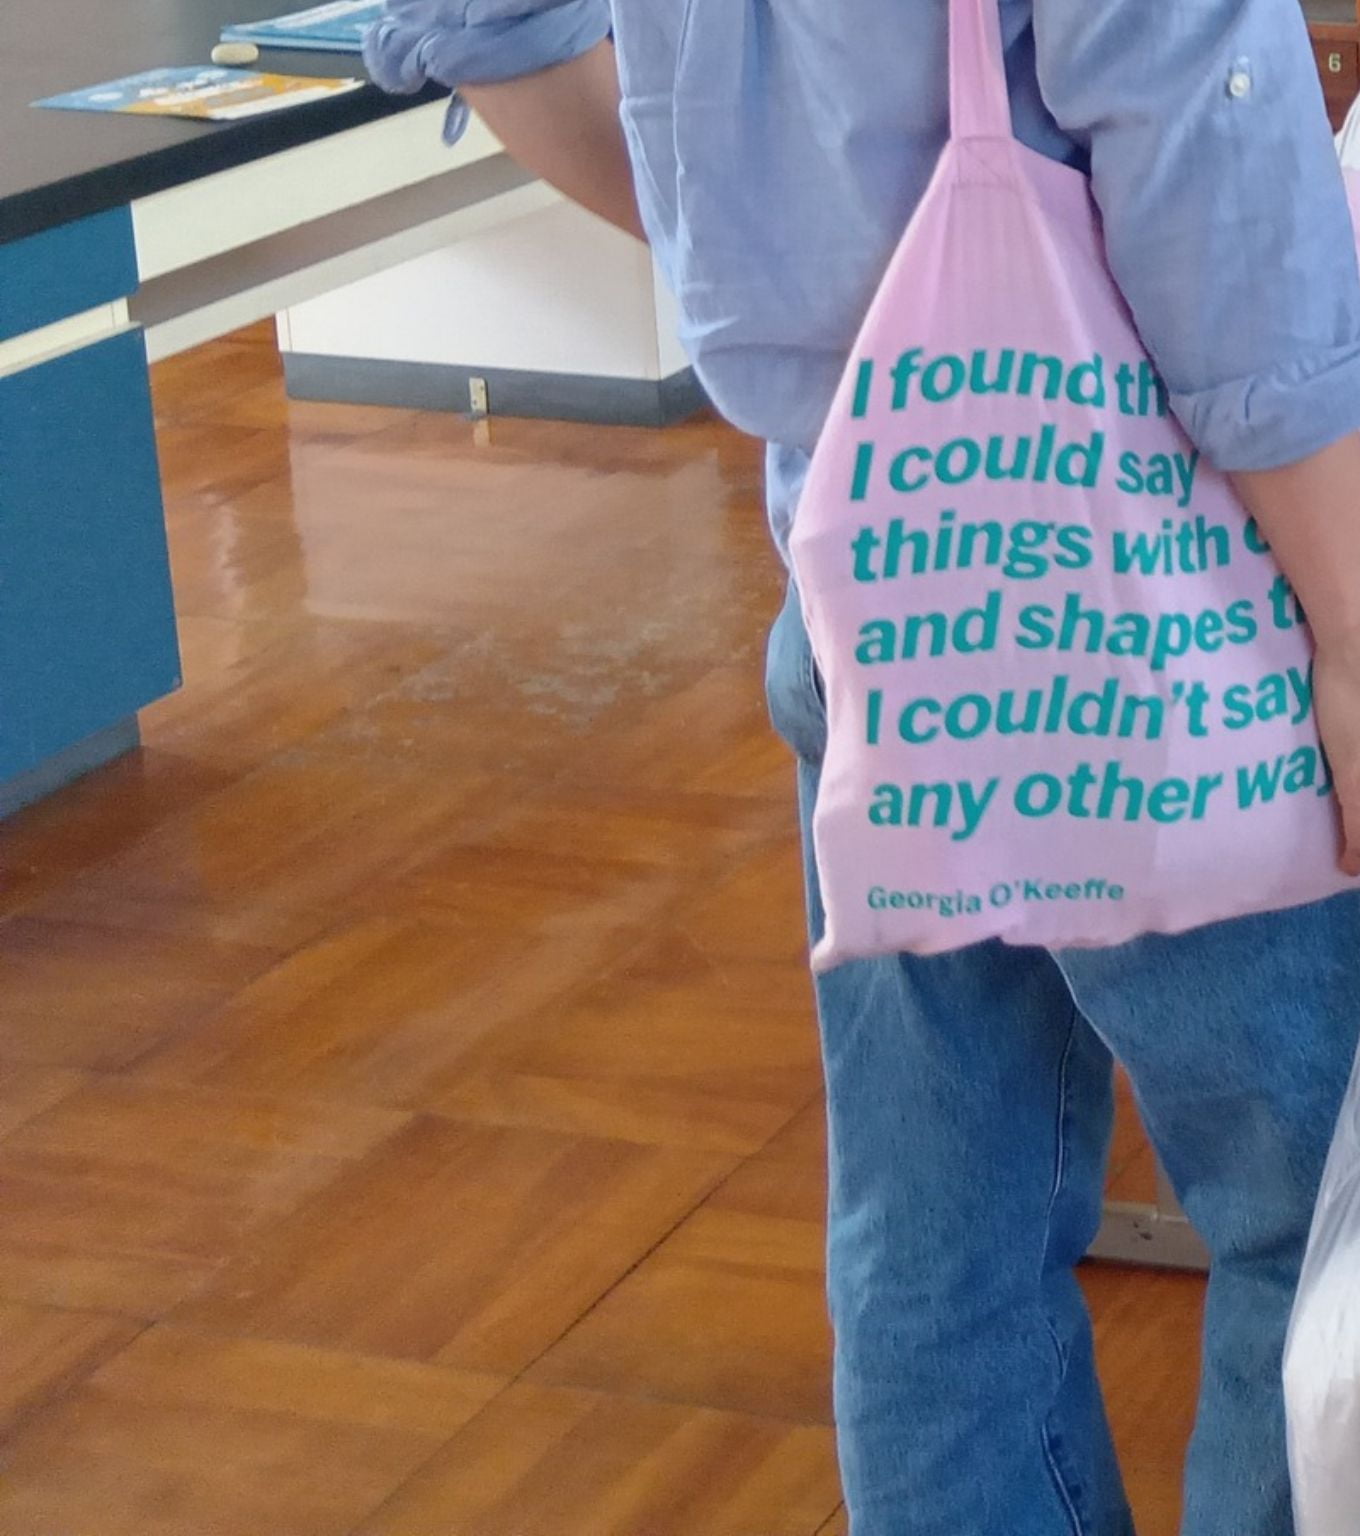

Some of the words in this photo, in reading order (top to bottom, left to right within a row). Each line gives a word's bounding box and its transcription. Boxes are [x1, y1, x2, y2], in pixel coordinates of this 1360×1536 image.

[1328, 52, 1341, 73] 6
[851, 360, 874, 419] I
[890, 347, 1105, 412] found
[849, 441, 873, 502] I
[888, 422, 1106, 490] could
[1115, 449, 1199, 509] say
[850, 509, 1094, 583] things
[1111, 514, 1231, 576] with
[854, 591, 1001, 665] and
[1015, 592, 1259, 671] shapes
[865, 688, 884, 746] I
[897, 673, 1211, 745] couldn't
[1221, 660, 1314, 731] say
[868, 777, 999, 843] any
[1012, 759, 1223, 824] other
[867, 885, 983, 917] Georgia
[989, 877, 1125, 908] O'Keeffe
